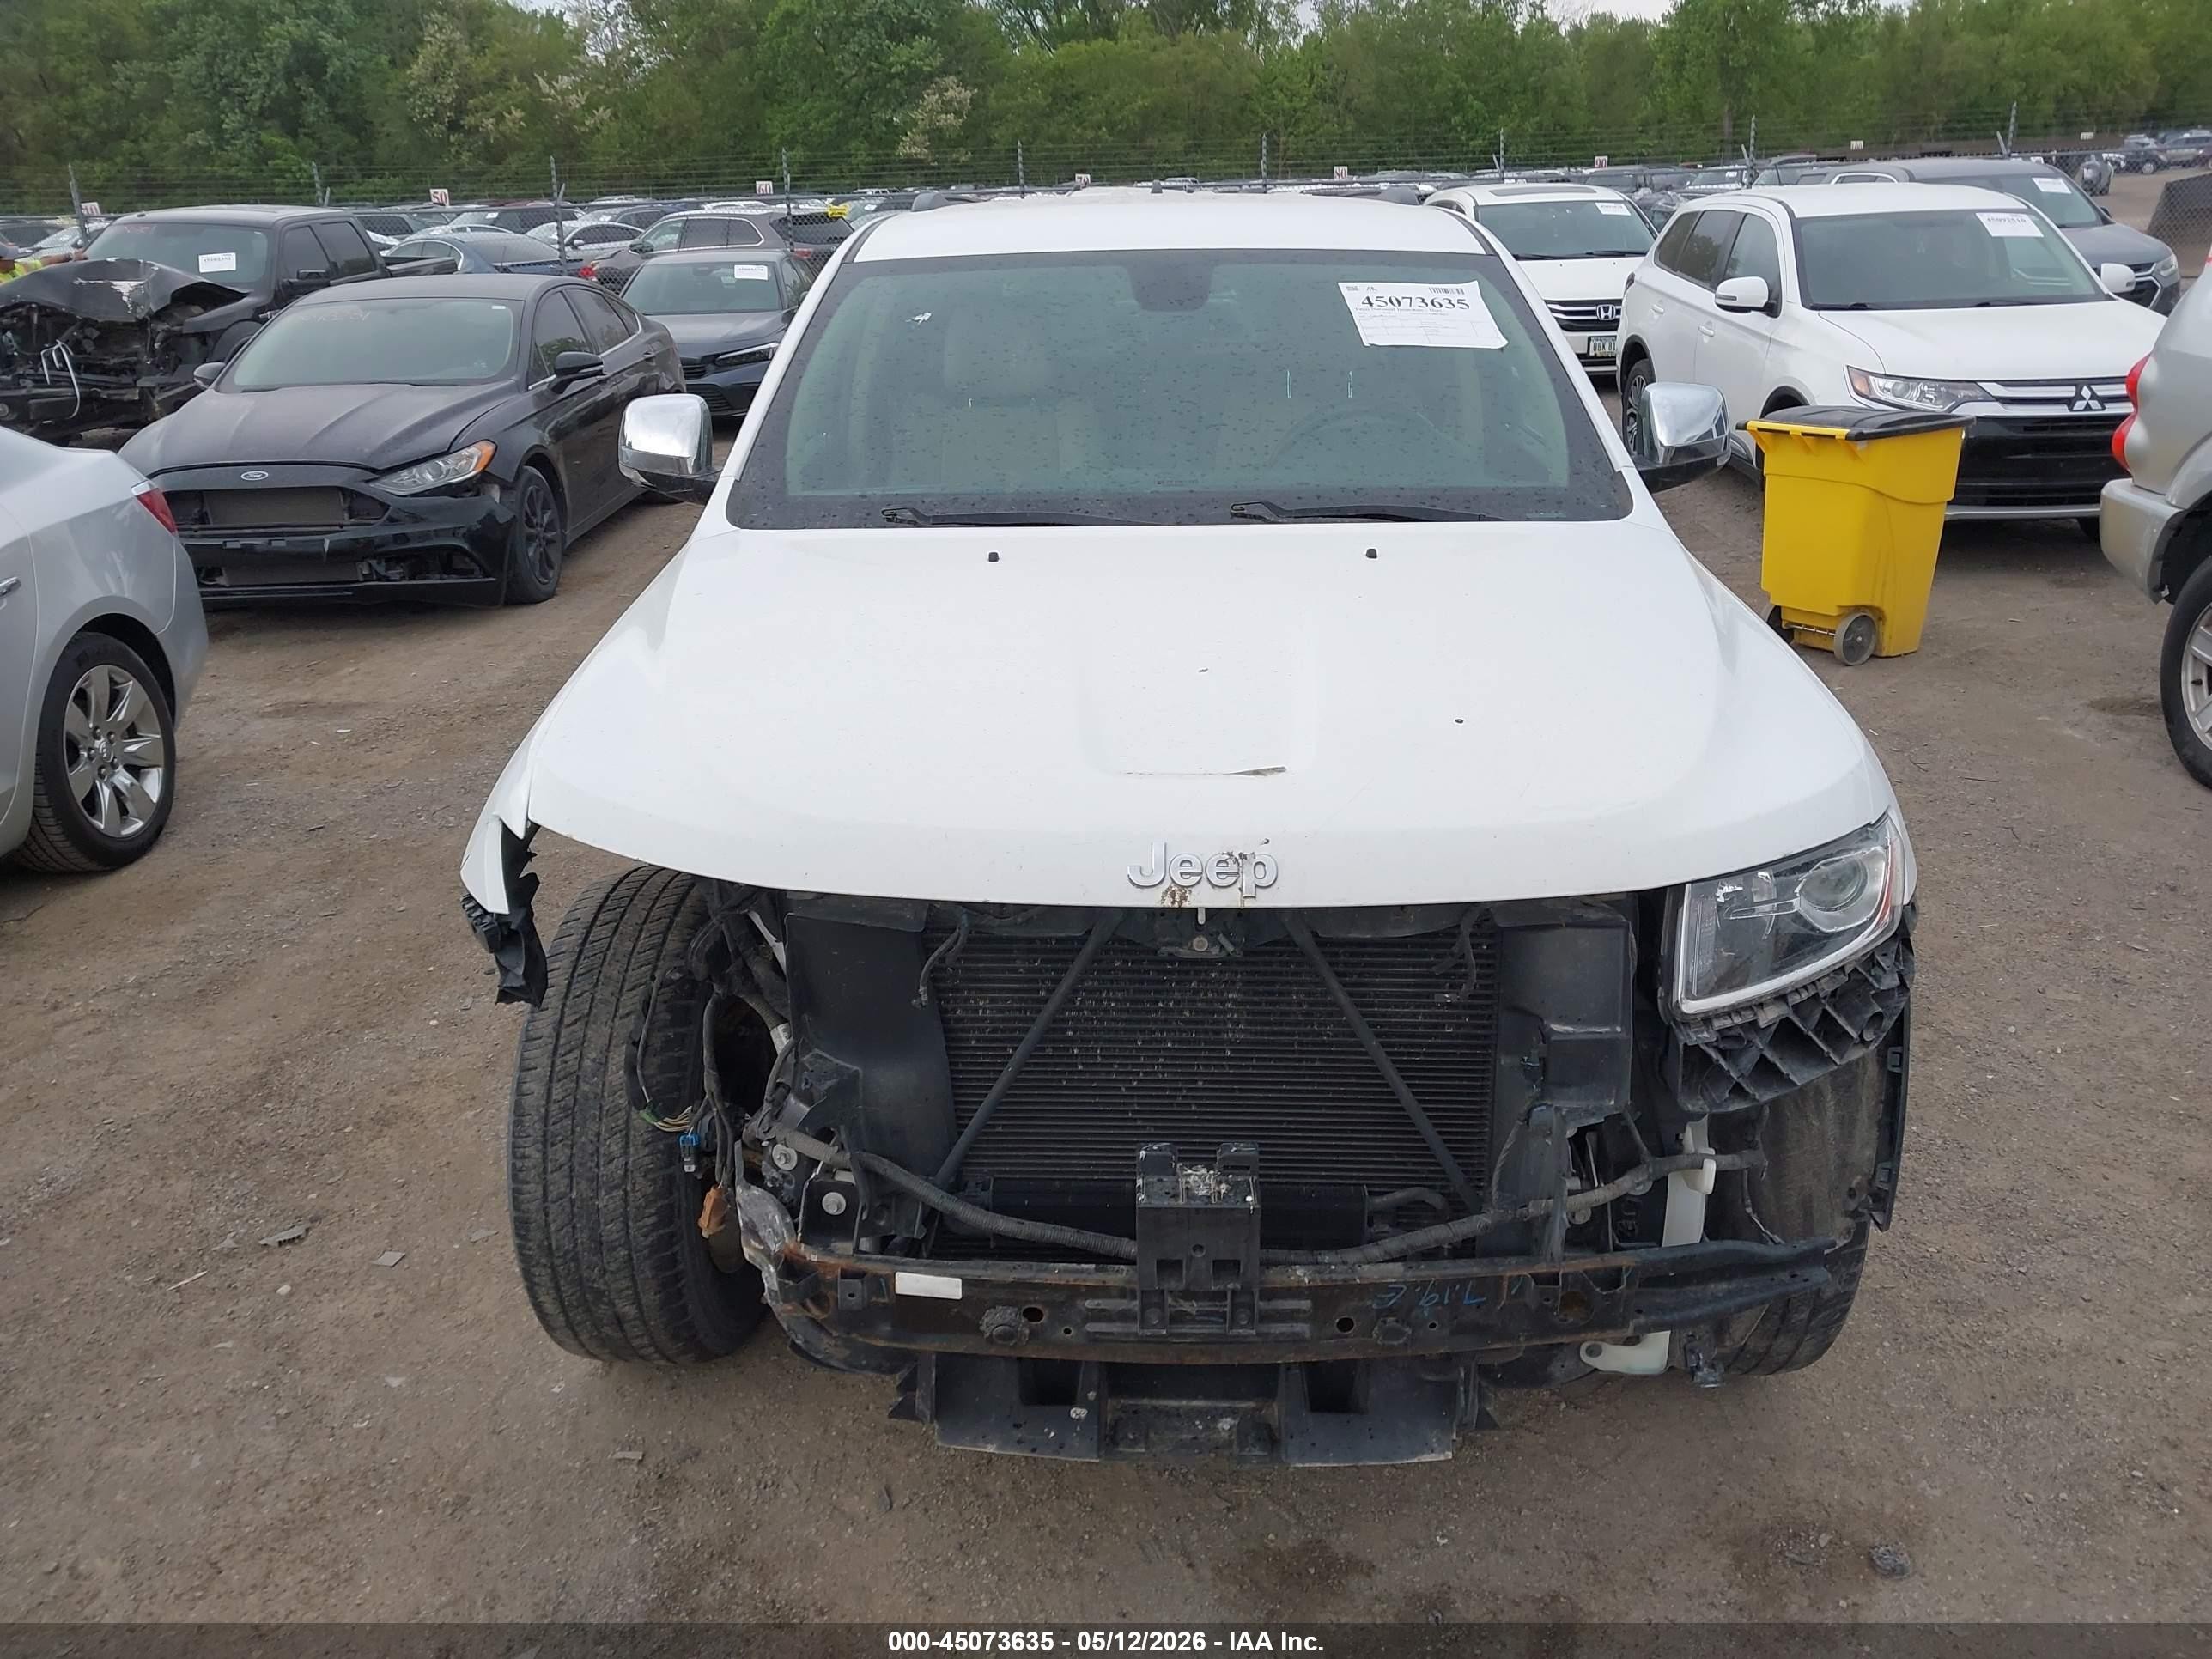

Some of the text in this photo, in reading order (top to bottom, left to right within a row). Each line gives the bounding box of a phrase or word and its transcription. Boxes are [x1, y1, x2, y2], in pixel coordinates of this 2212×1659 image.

[1595, 158, 1607, 168] 90
[1335, 167, 1346, 179] 80
[758, 183, 772, 195] 60
[433, 191, 447, 204] 50
[1362, 295, 1470, 310] 45073635
[1127, 838, 1279, 899] Jeep
